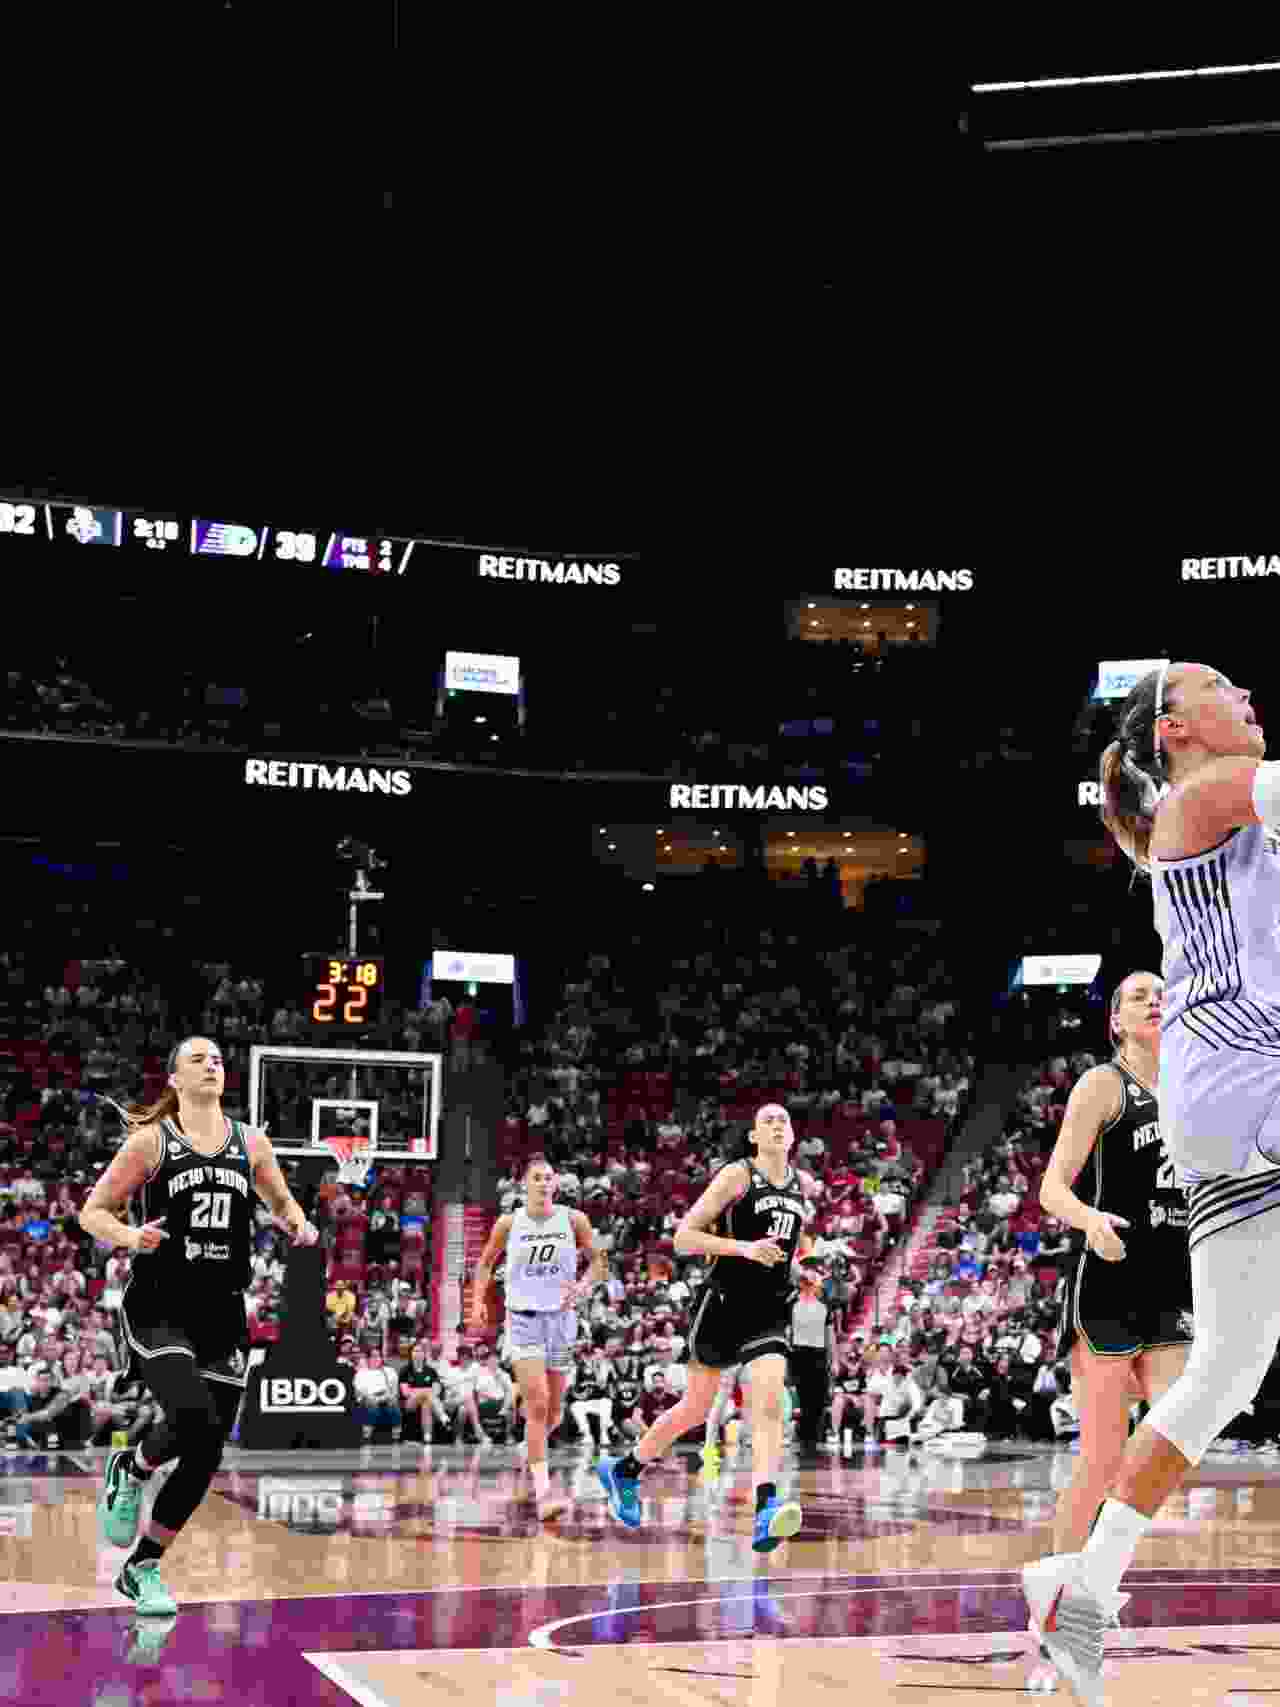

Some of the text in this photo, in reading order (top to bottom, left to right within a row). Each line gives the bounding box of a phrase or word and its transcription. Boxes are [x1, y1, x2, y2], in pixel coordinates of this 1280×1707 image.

[479, 554, 621, 585] REITMANS
[834, 567, 974, 591] REITMANS
[245, 759, 412, 795] REITMANS
[669, 783, 829, 811] REITMANS
[328, 961, 377, 987] 3:18
[313, 984, 368, 1023] 22
[190, 1192, 232, 1229] 20
[528, 1243, 556, 1265] 10
[266, 1379, 346, 1408] BDO
